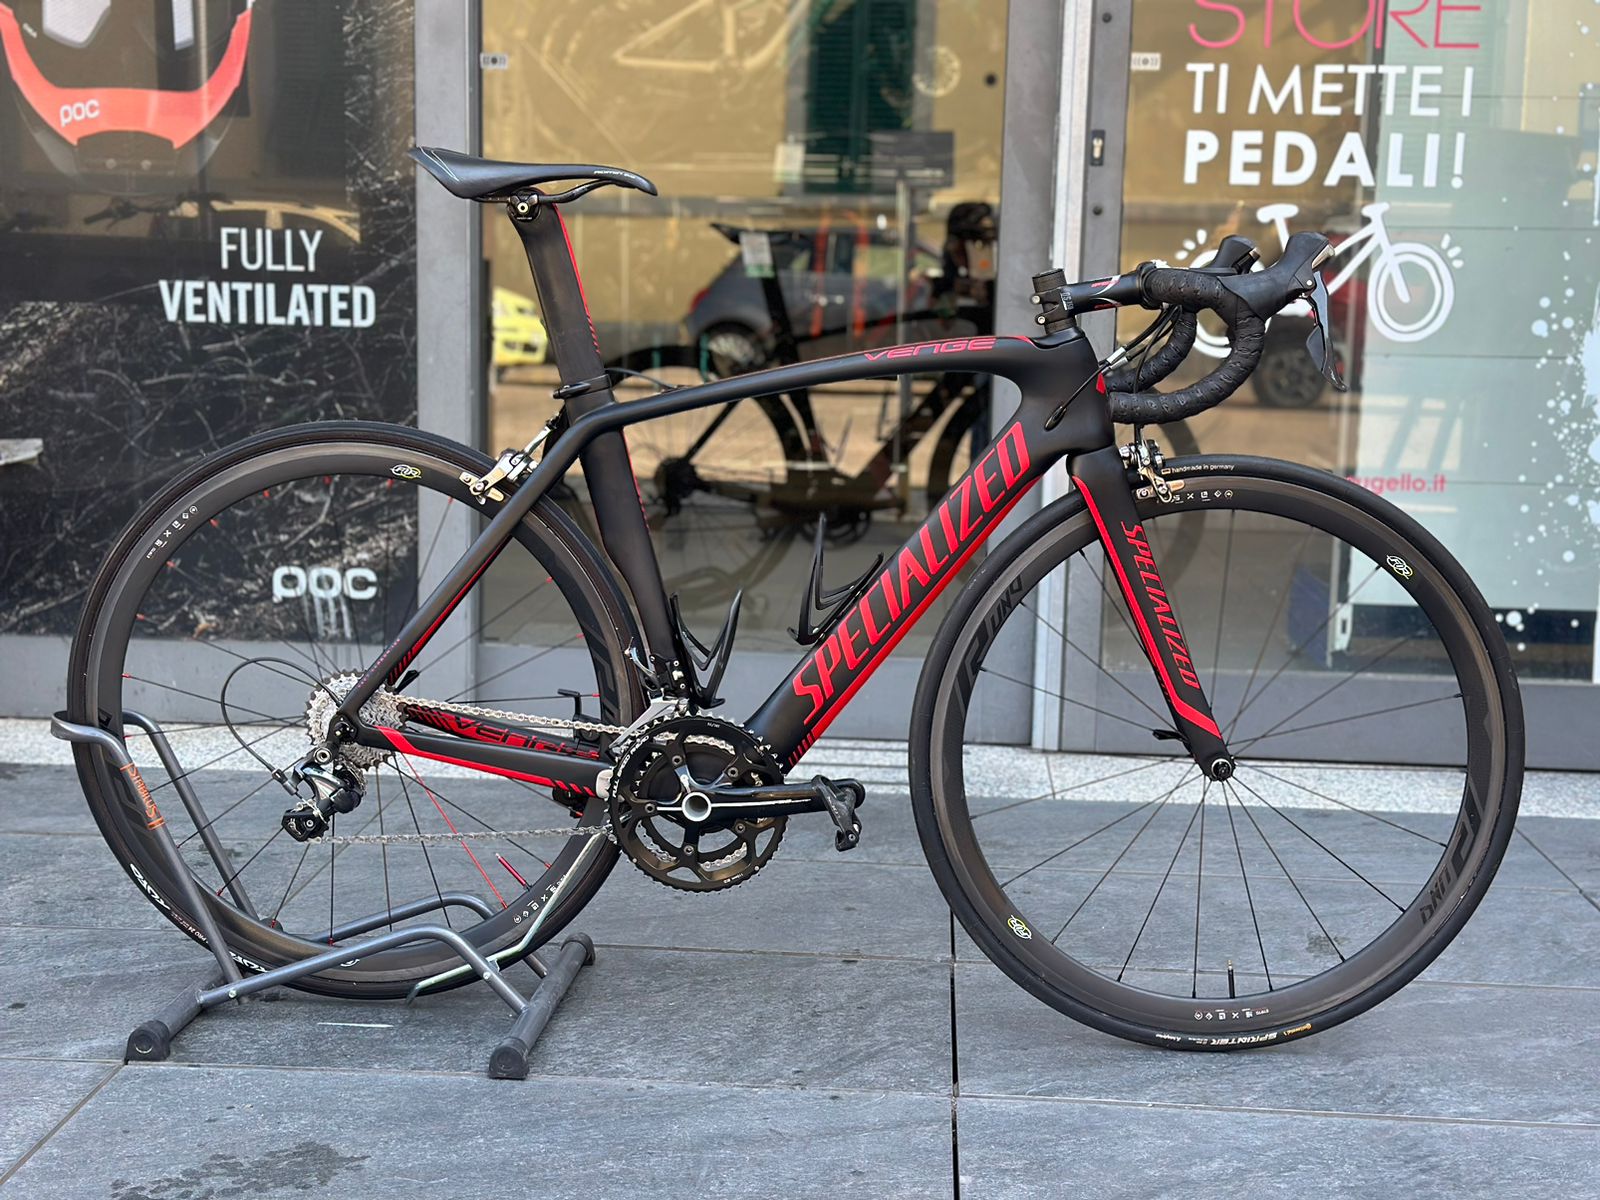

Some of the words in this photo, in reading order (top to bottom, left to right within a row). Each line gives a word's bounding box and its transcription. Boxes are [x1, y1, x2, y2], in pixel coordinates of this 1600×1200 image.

[1189, 0, 1482, 49] STORE
[1186, 63, 1229, 114] TI
[1248, 65, 1444, 117] METTE
[1461, 66, 1474, 117] I
[1184, 130, 1466, 190] PEDALI!
[220, 228, 323, 272] FULLY
[158, 279, 376, 328] VENTILATED
[1171, 465, 1202, 474] handmade
[1203, 463, 1209, 471] in
[1210, 463, 1235, 472] germany
[1346, 474, 1447, 496] ugello.it
[792, 421, 1031, 725] SPECIALIZED
[1120, 520, 1200, 690] SPECIALIZED
[612, 779, 620, 798] FULL
[617, 754, 631, 777] SPEED
[194, 931, 208, 942] PRO
[1211, 1032, 1278, 1046] SPRINTER
